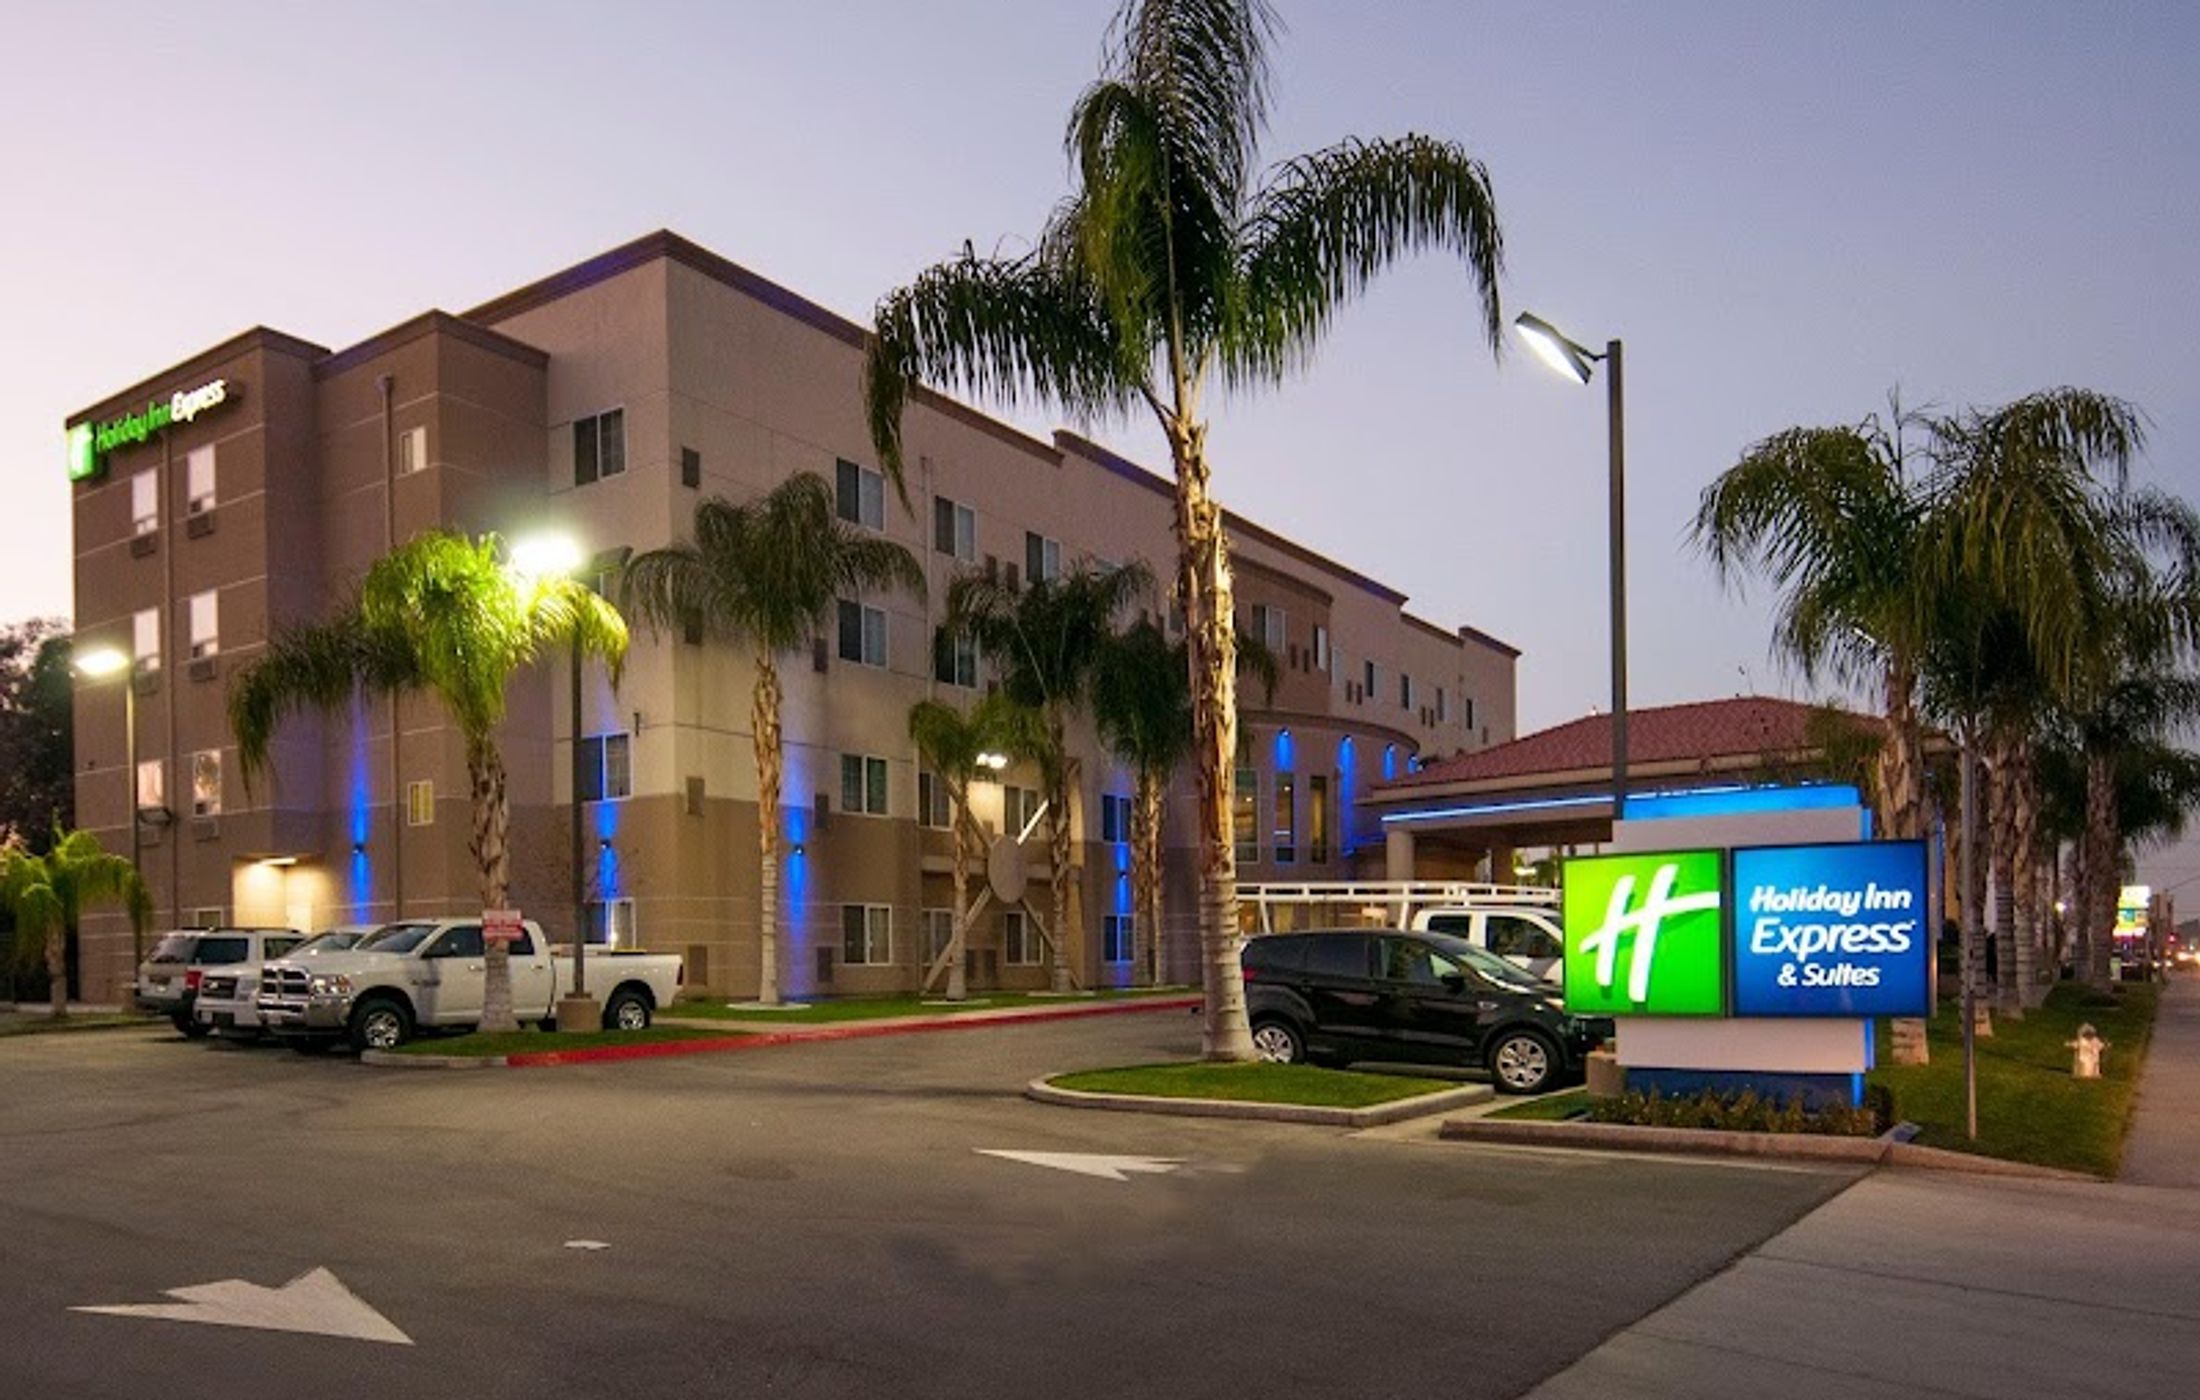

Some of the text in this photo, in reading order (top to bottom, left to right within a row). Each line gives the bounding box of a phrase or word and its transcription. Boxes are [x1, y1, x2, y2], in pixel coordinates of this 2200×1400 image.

[96, 411, 147, 452] Holiday
[171, 379, 226, 422] Express
[1750, 883, 1912, 917] Holiday Inn
[1750, 918, 1913, 962] Express
[1777, 963, 1880, 987] & Suites
